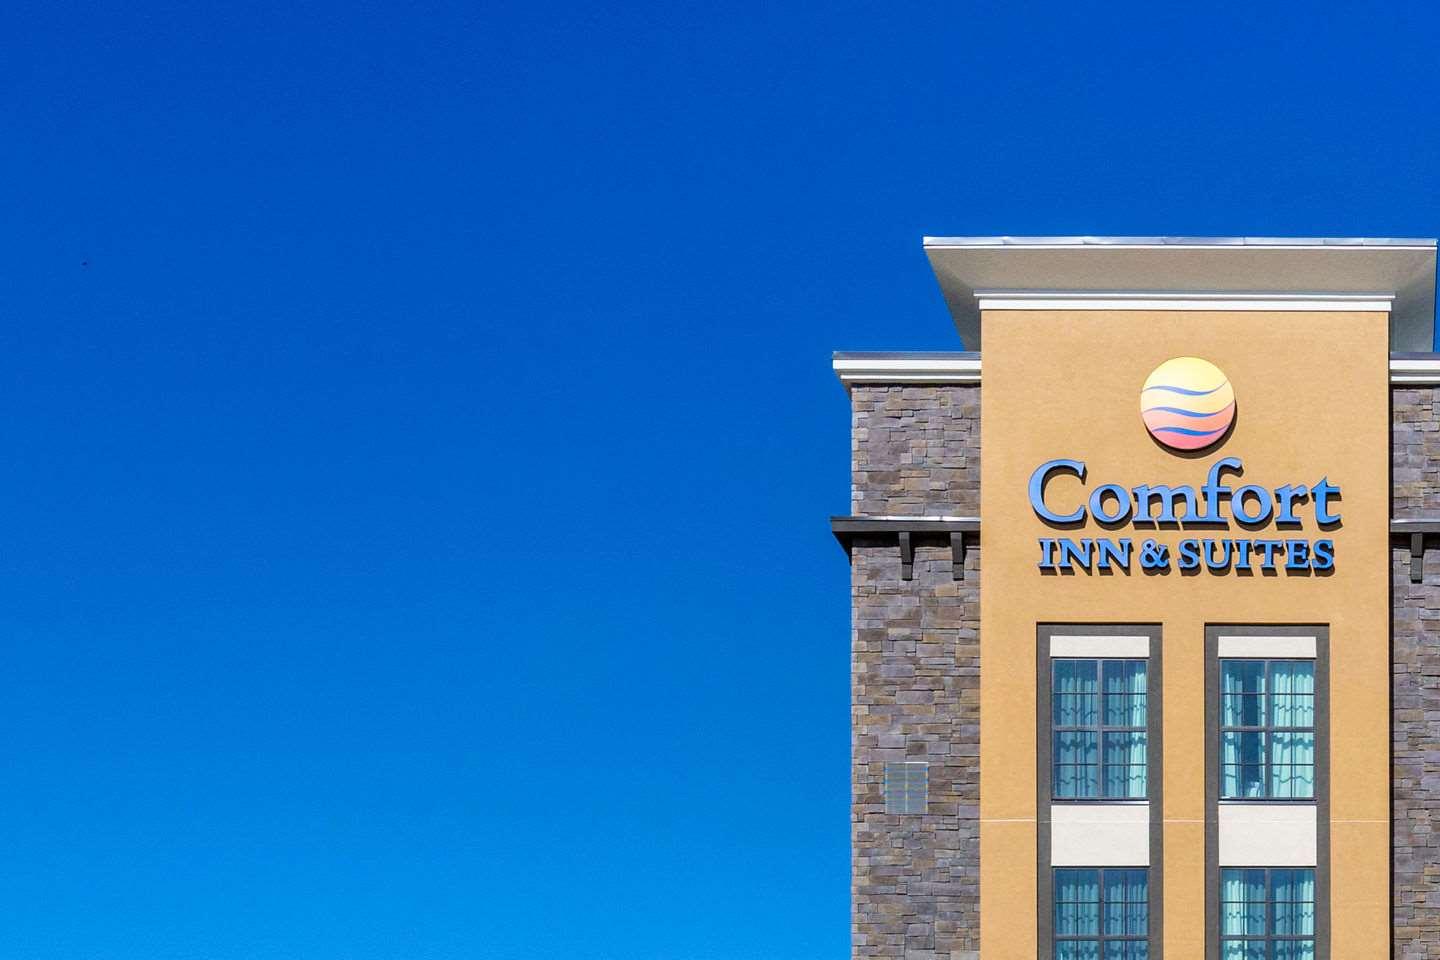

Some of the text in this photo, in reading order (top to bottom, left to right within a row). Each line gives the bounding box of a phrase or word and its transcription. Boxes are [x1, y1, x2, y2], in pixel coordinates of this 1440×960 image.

[1028, 457, 1343, 528] Comfort
[1038, 538, 1335, 574] INN & SUITES
